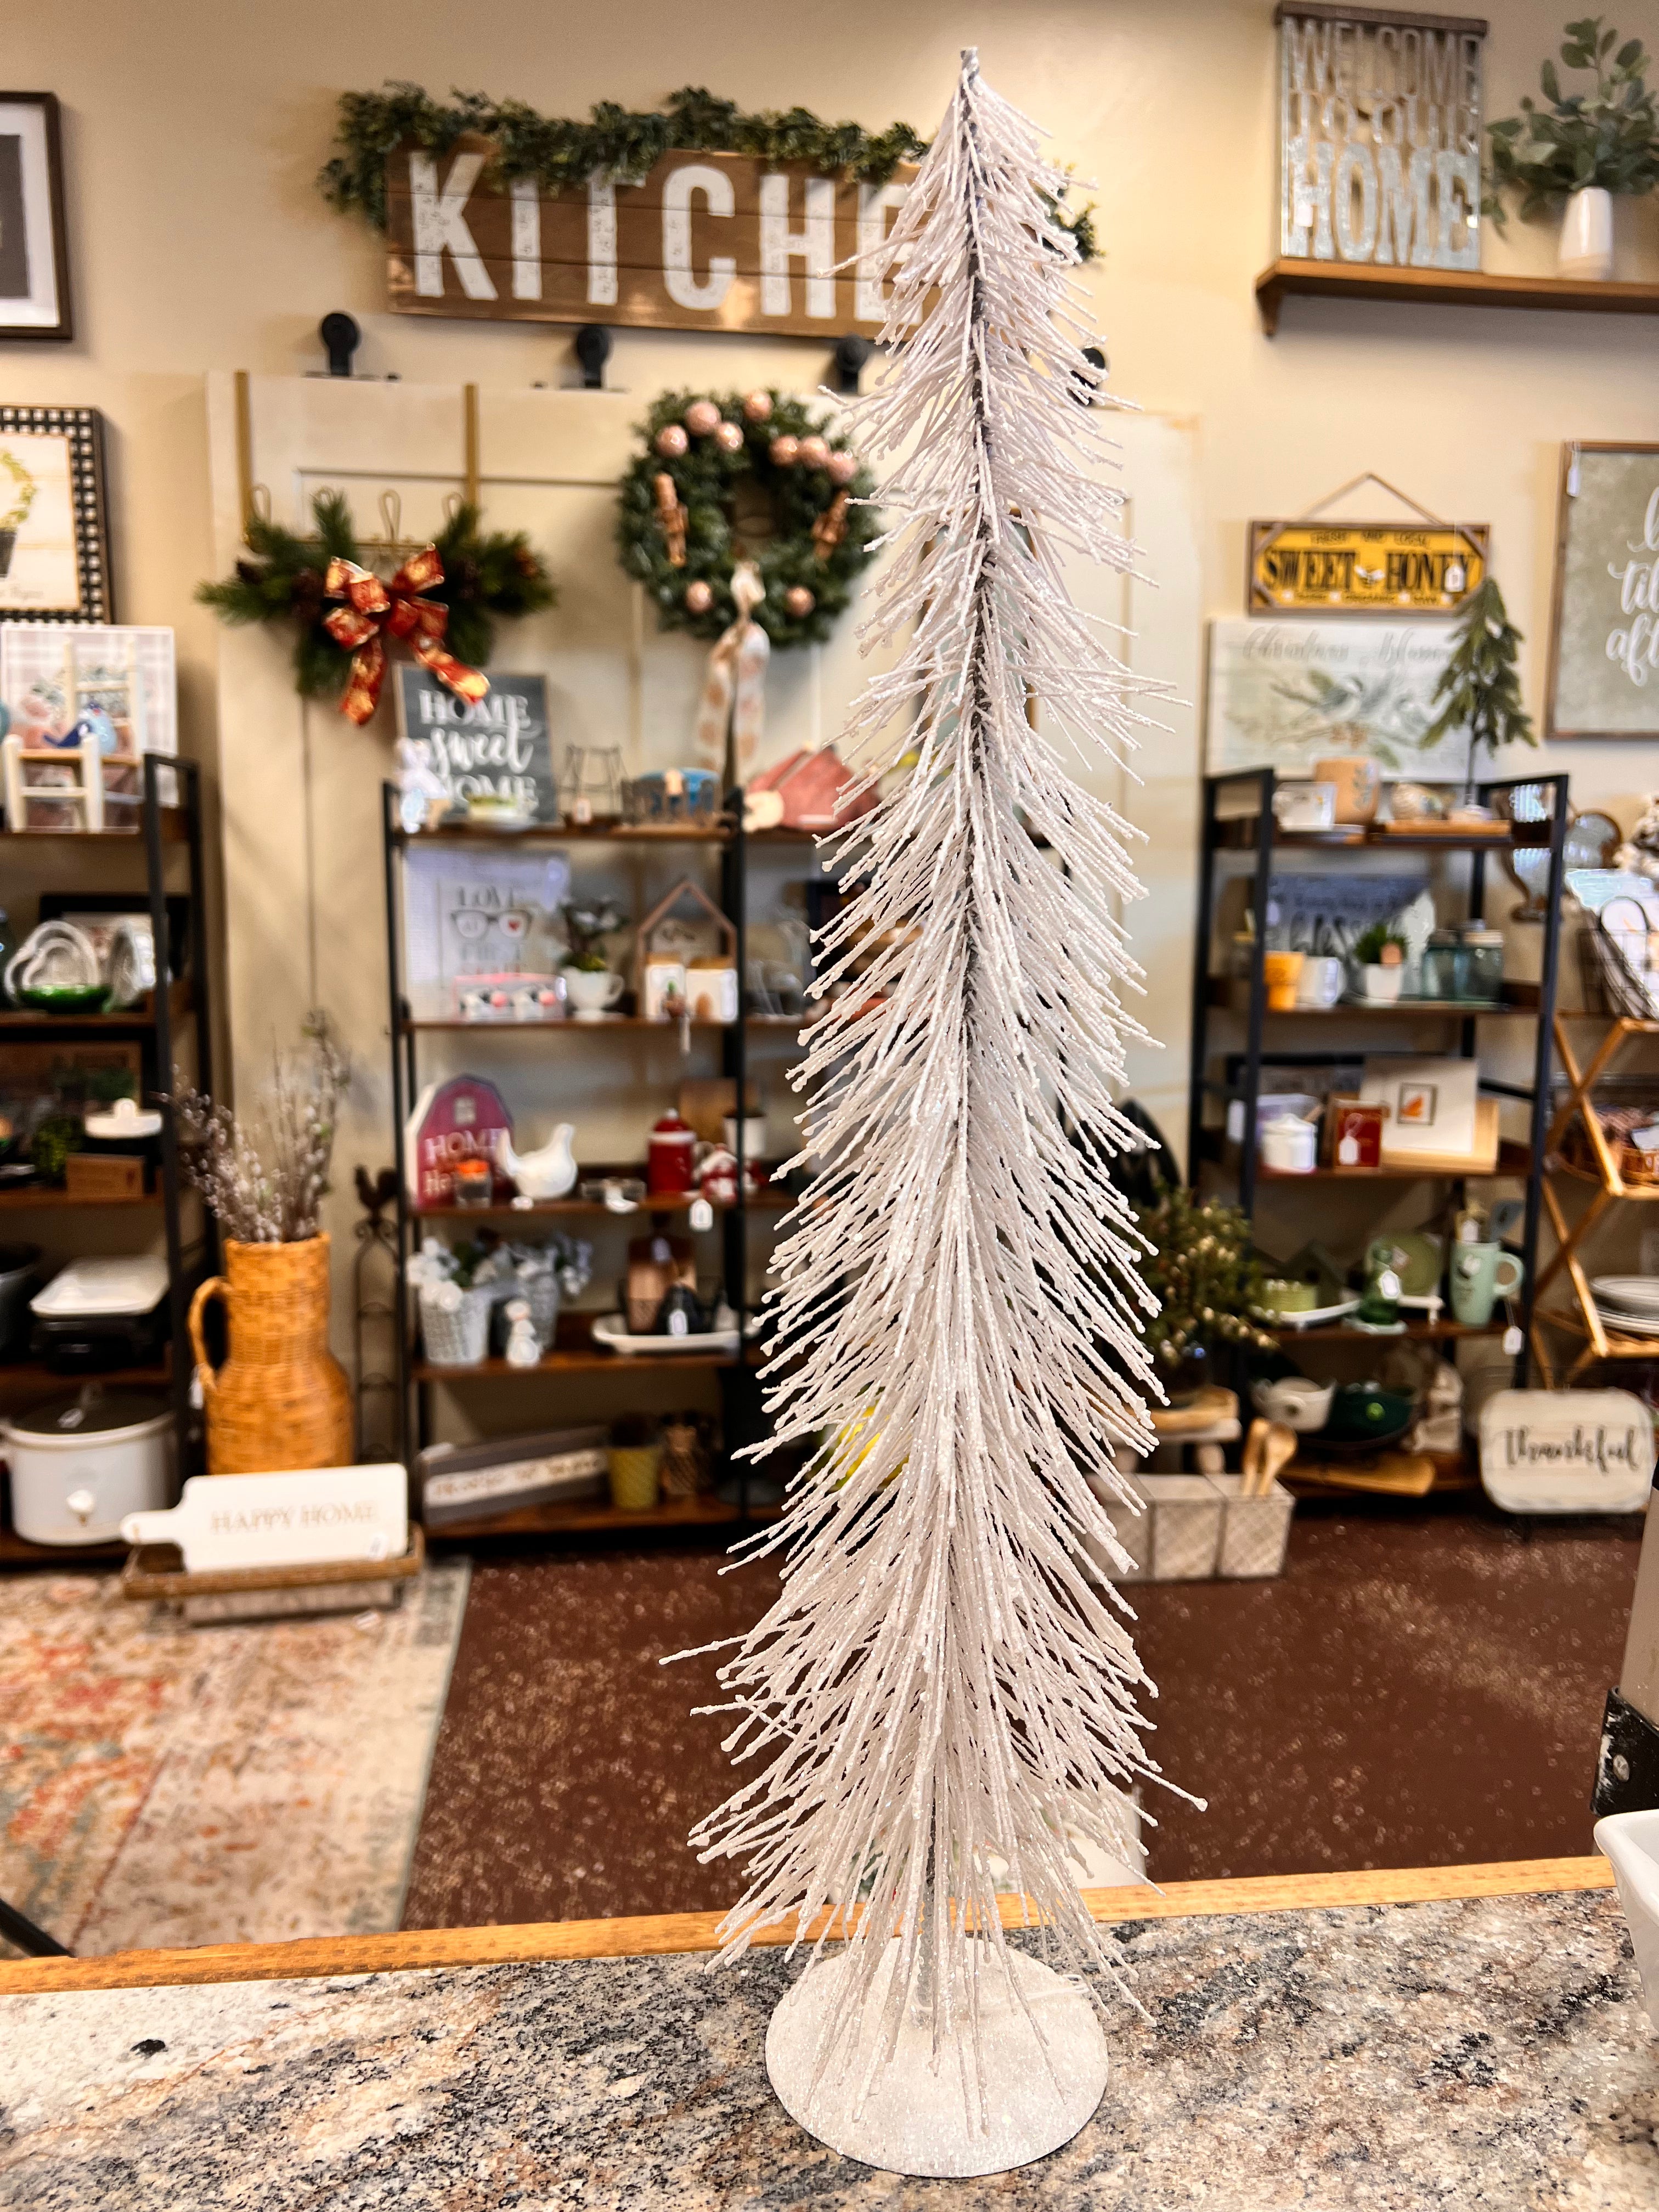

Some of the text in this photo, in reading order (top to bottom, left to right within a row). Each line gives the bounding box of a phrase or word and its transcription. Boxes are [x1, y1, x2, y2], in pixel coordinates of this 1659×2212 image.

[1288, 136, 1480, 270] HOME
[408, 149, 927, 326] KITCHE
[1263, 546, 1357, 594] SWEET
[418, 689, 532, 730] HOME
[439, 772, 540, 811] OME
[210, 1500, 380, 1535] HAPPY HOME
